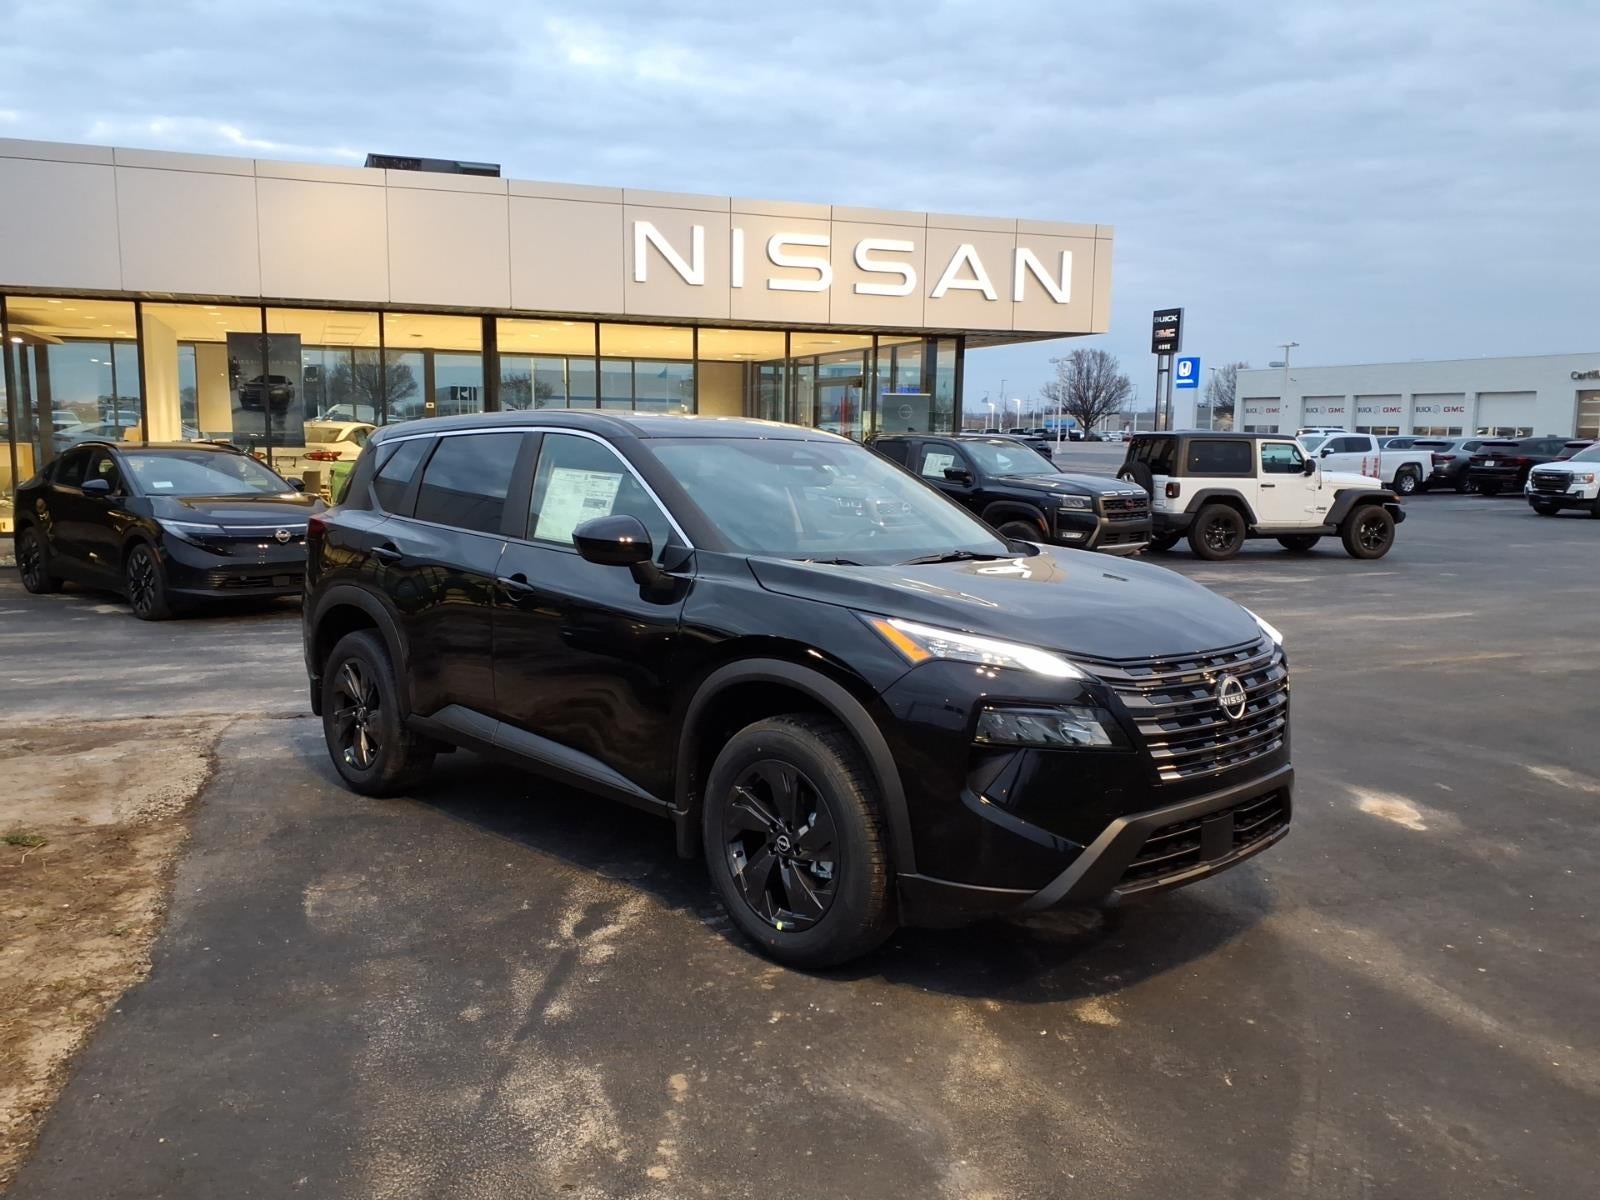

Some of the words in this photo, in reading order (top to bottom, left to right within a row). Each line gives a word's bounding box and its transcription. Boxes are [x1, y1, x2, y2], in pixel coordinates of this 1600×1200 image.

[633, 220, 1073, 304] NISSAN
[1154, 314, 1178, 323] BUICK
[1155, 328, 1176, 338] GMC
